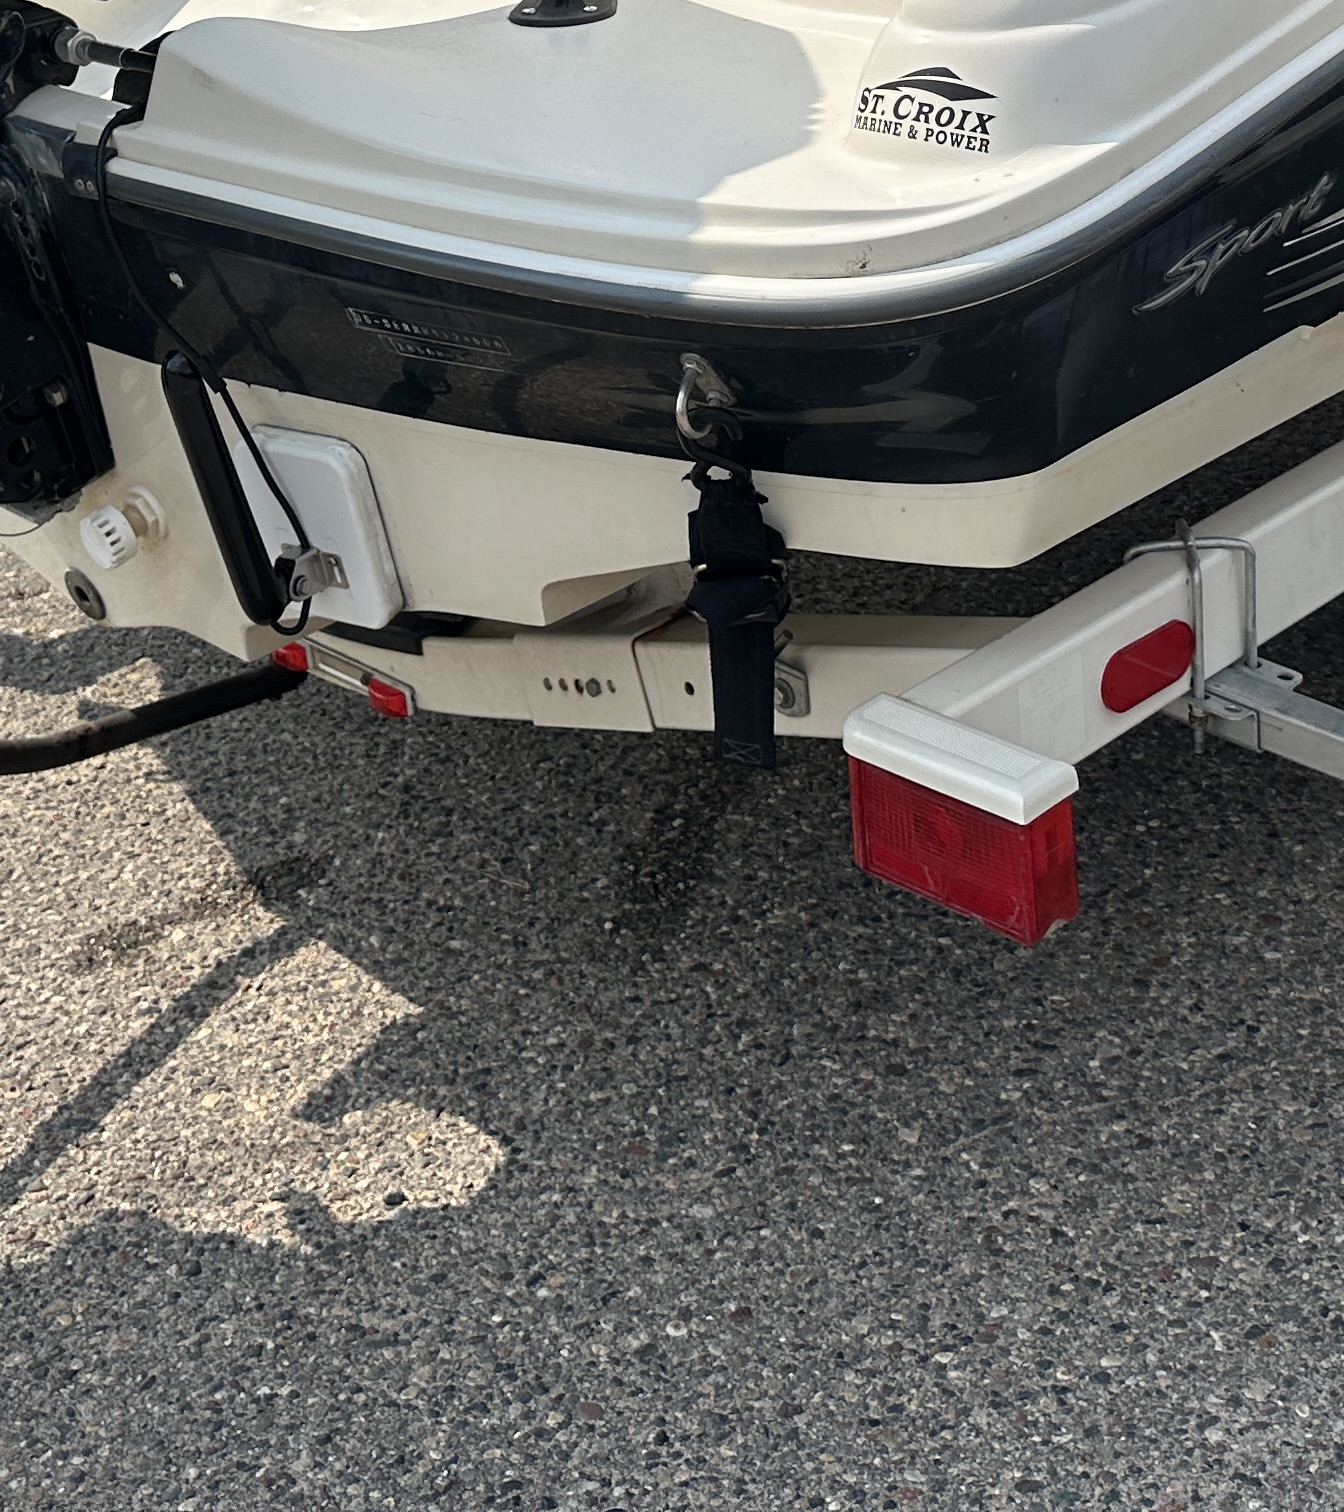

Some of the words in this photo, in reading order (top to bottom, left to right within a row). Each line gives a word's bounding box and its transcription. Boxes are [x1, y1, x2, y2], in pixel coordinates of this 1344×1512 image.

[854, 114, 903, 137] MARINE
[907, 124, 919, 141] &
[923, 127, 991, 154] POWER
[892, 93, 997, 136] CROIX
[1133, 170, 1335, 316] Sport
